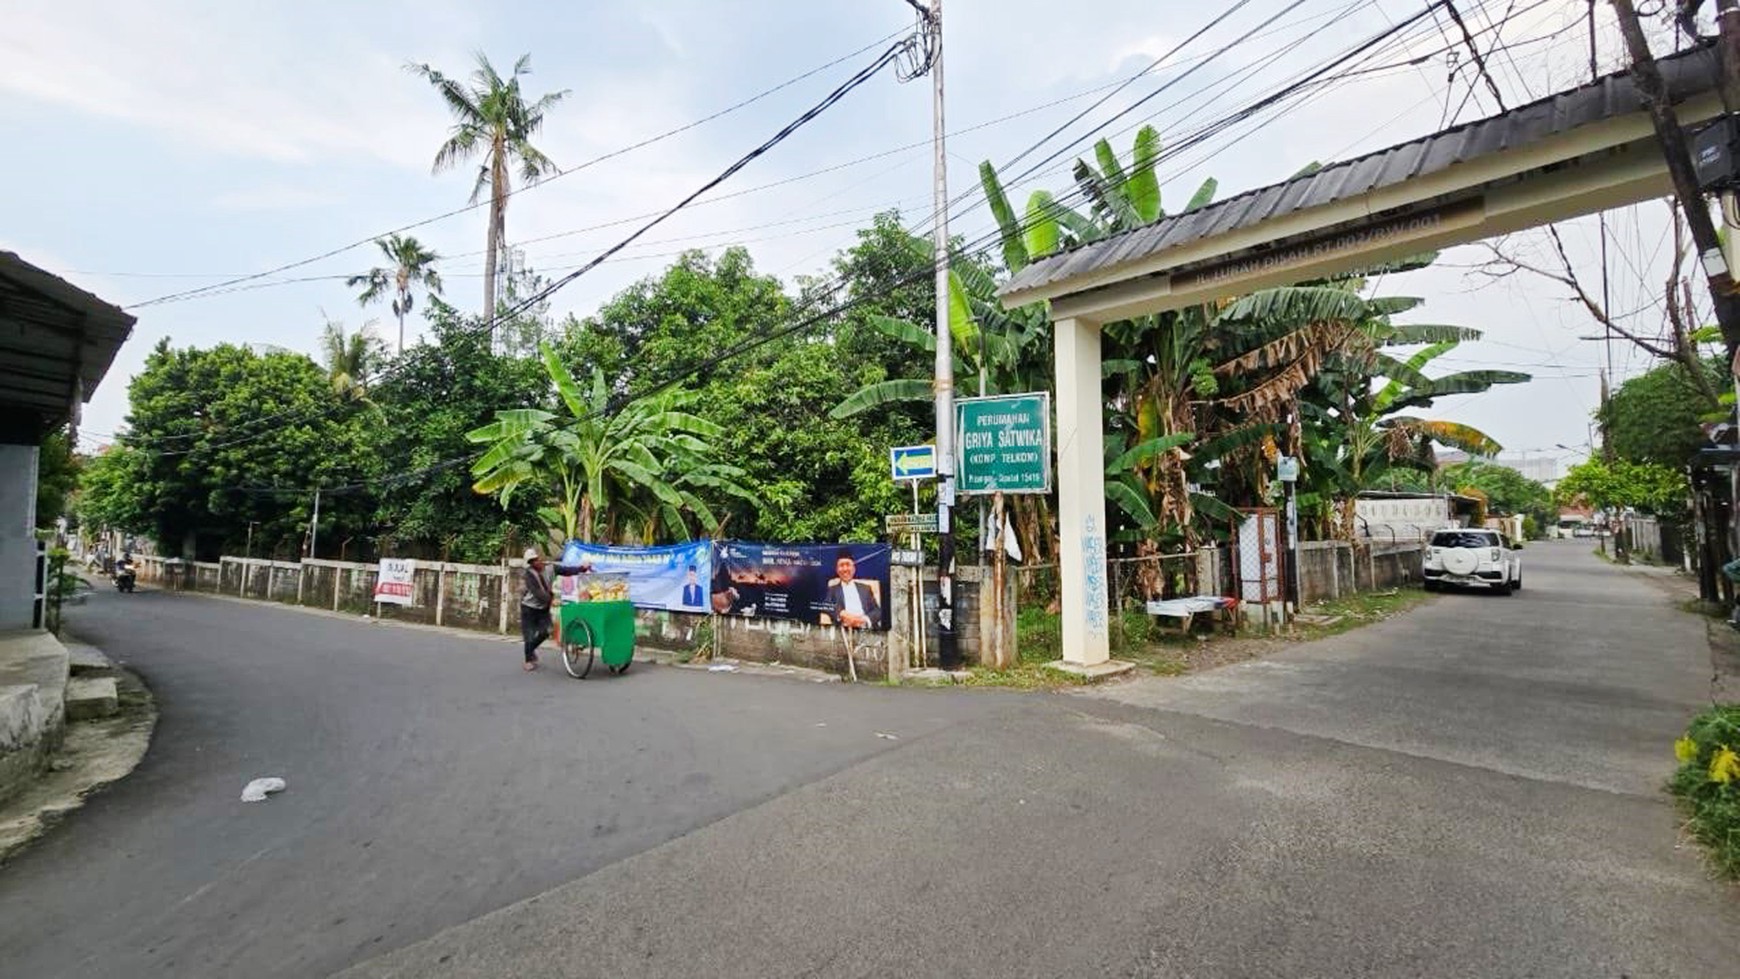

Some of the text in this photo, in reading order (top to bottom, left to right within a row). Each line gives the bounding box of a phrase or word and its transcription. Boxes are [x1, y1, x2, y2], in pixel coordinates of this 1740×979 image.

[977, 413, 1030, 426] PERUMAHAN
[965, 429, 1042, 449] GRIYA SATWIKA
